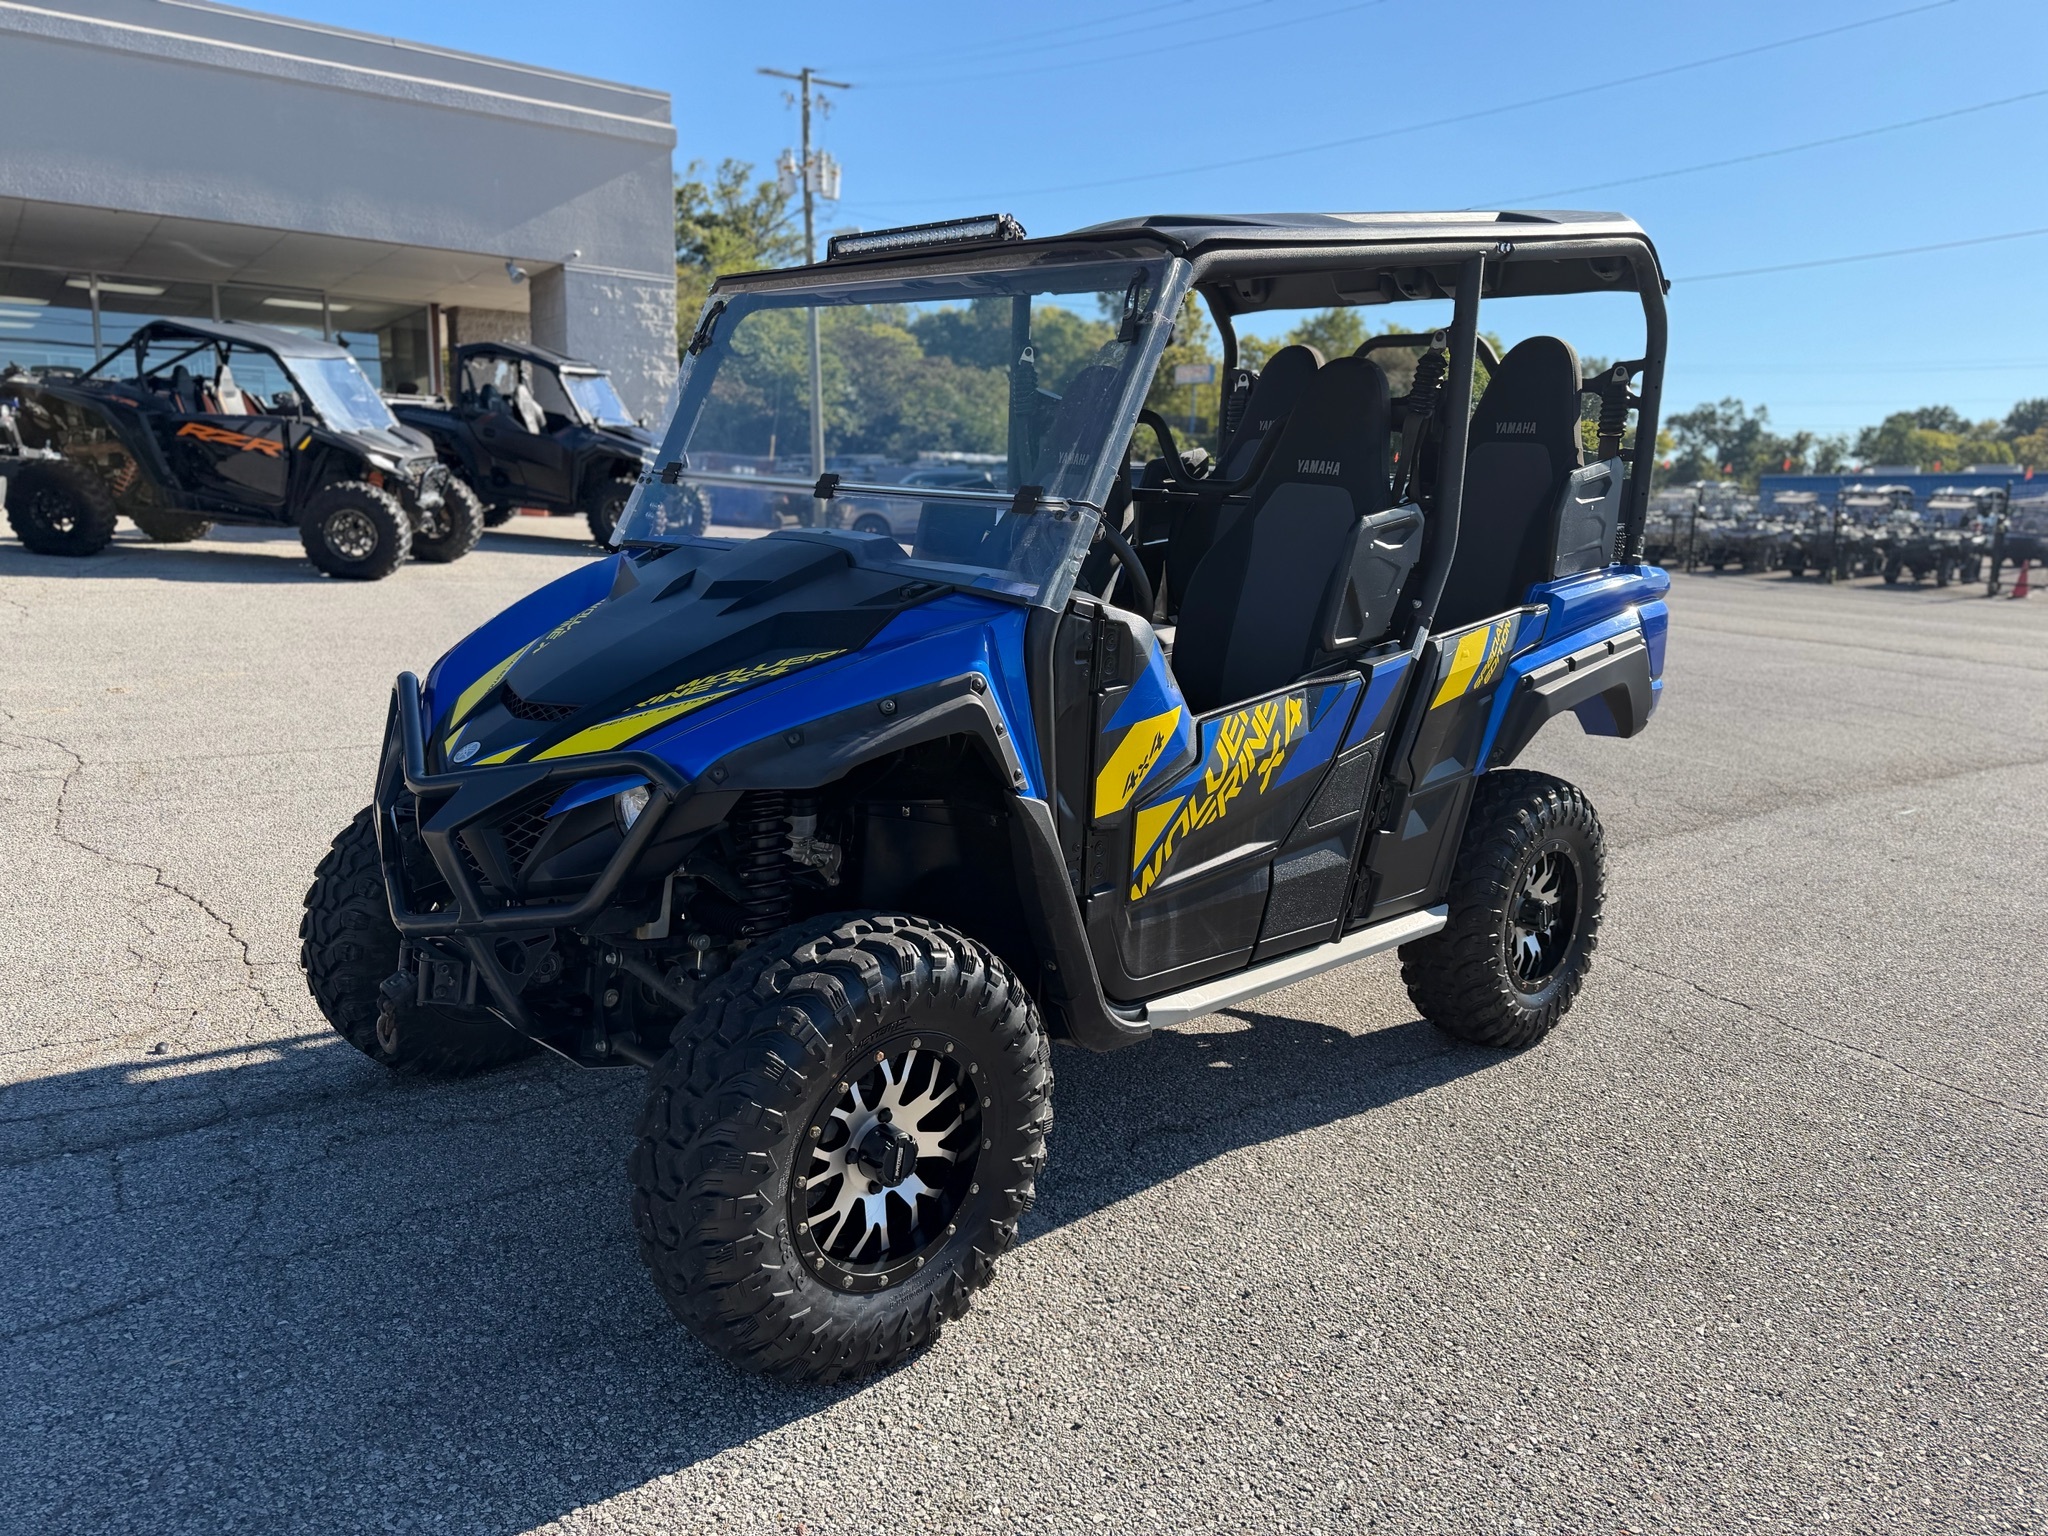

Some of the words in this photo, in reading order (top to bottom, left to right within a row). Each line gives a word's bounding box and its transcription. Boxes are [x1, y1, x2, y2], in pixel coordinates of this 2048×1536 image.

[1495, 422, 1537, 435] YAMAHA
[176, 421, 284, 458] RZR
[1296, 459, 1341, 476] YAMAHA
